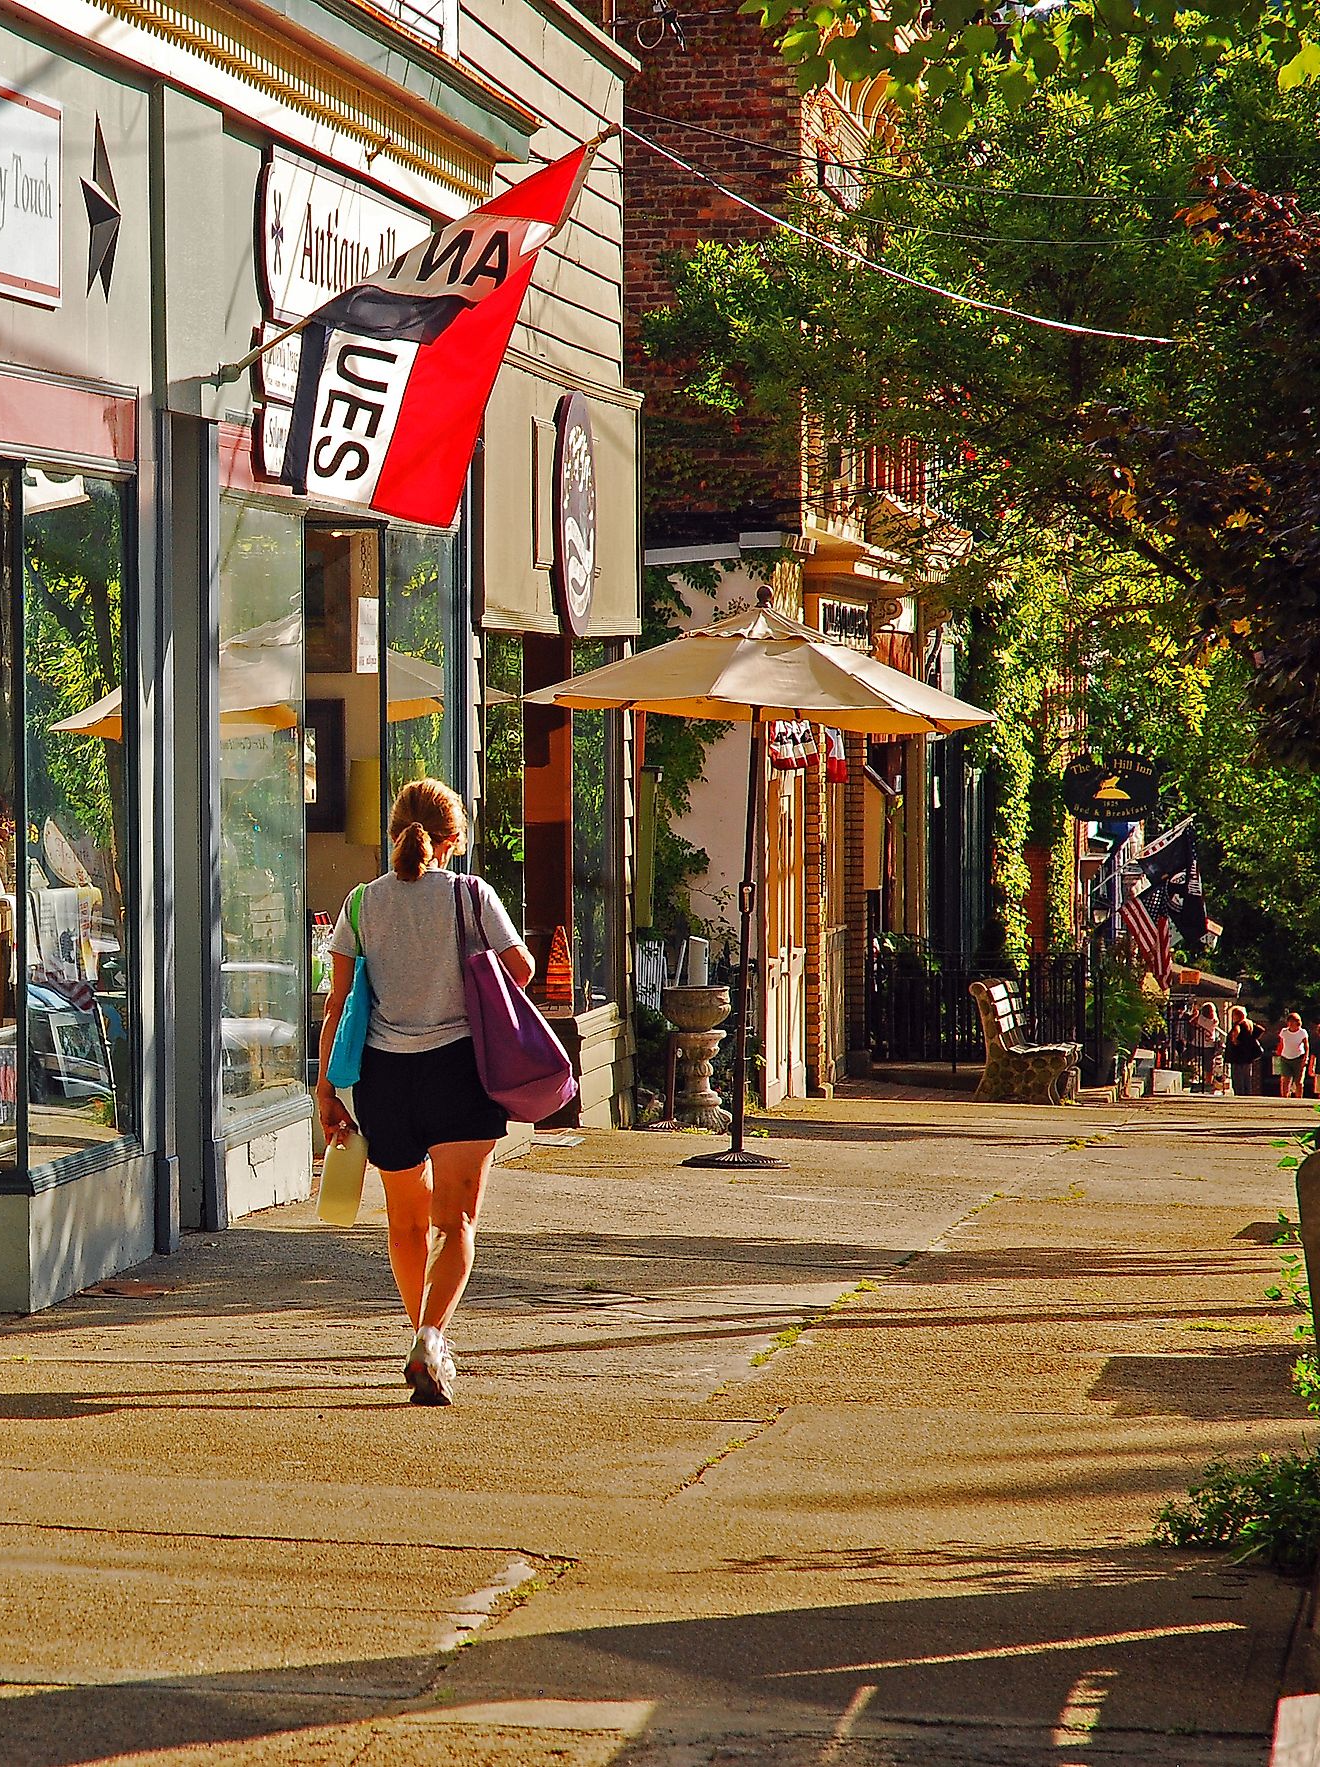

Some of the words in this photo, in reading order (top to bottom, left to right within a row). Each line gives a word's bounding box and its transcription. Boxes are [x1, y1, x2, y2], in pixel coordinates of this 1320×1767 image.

[12, 152, 53, 219] Touch
[300, 202, 370, 293] Antique
[1070, 763, 1091, 775] The
[1113, 758, 1133, 770] Hill
[1135, 762, 1153, 776] Inn
[1105, 804, 1148, 817] Breakfast
